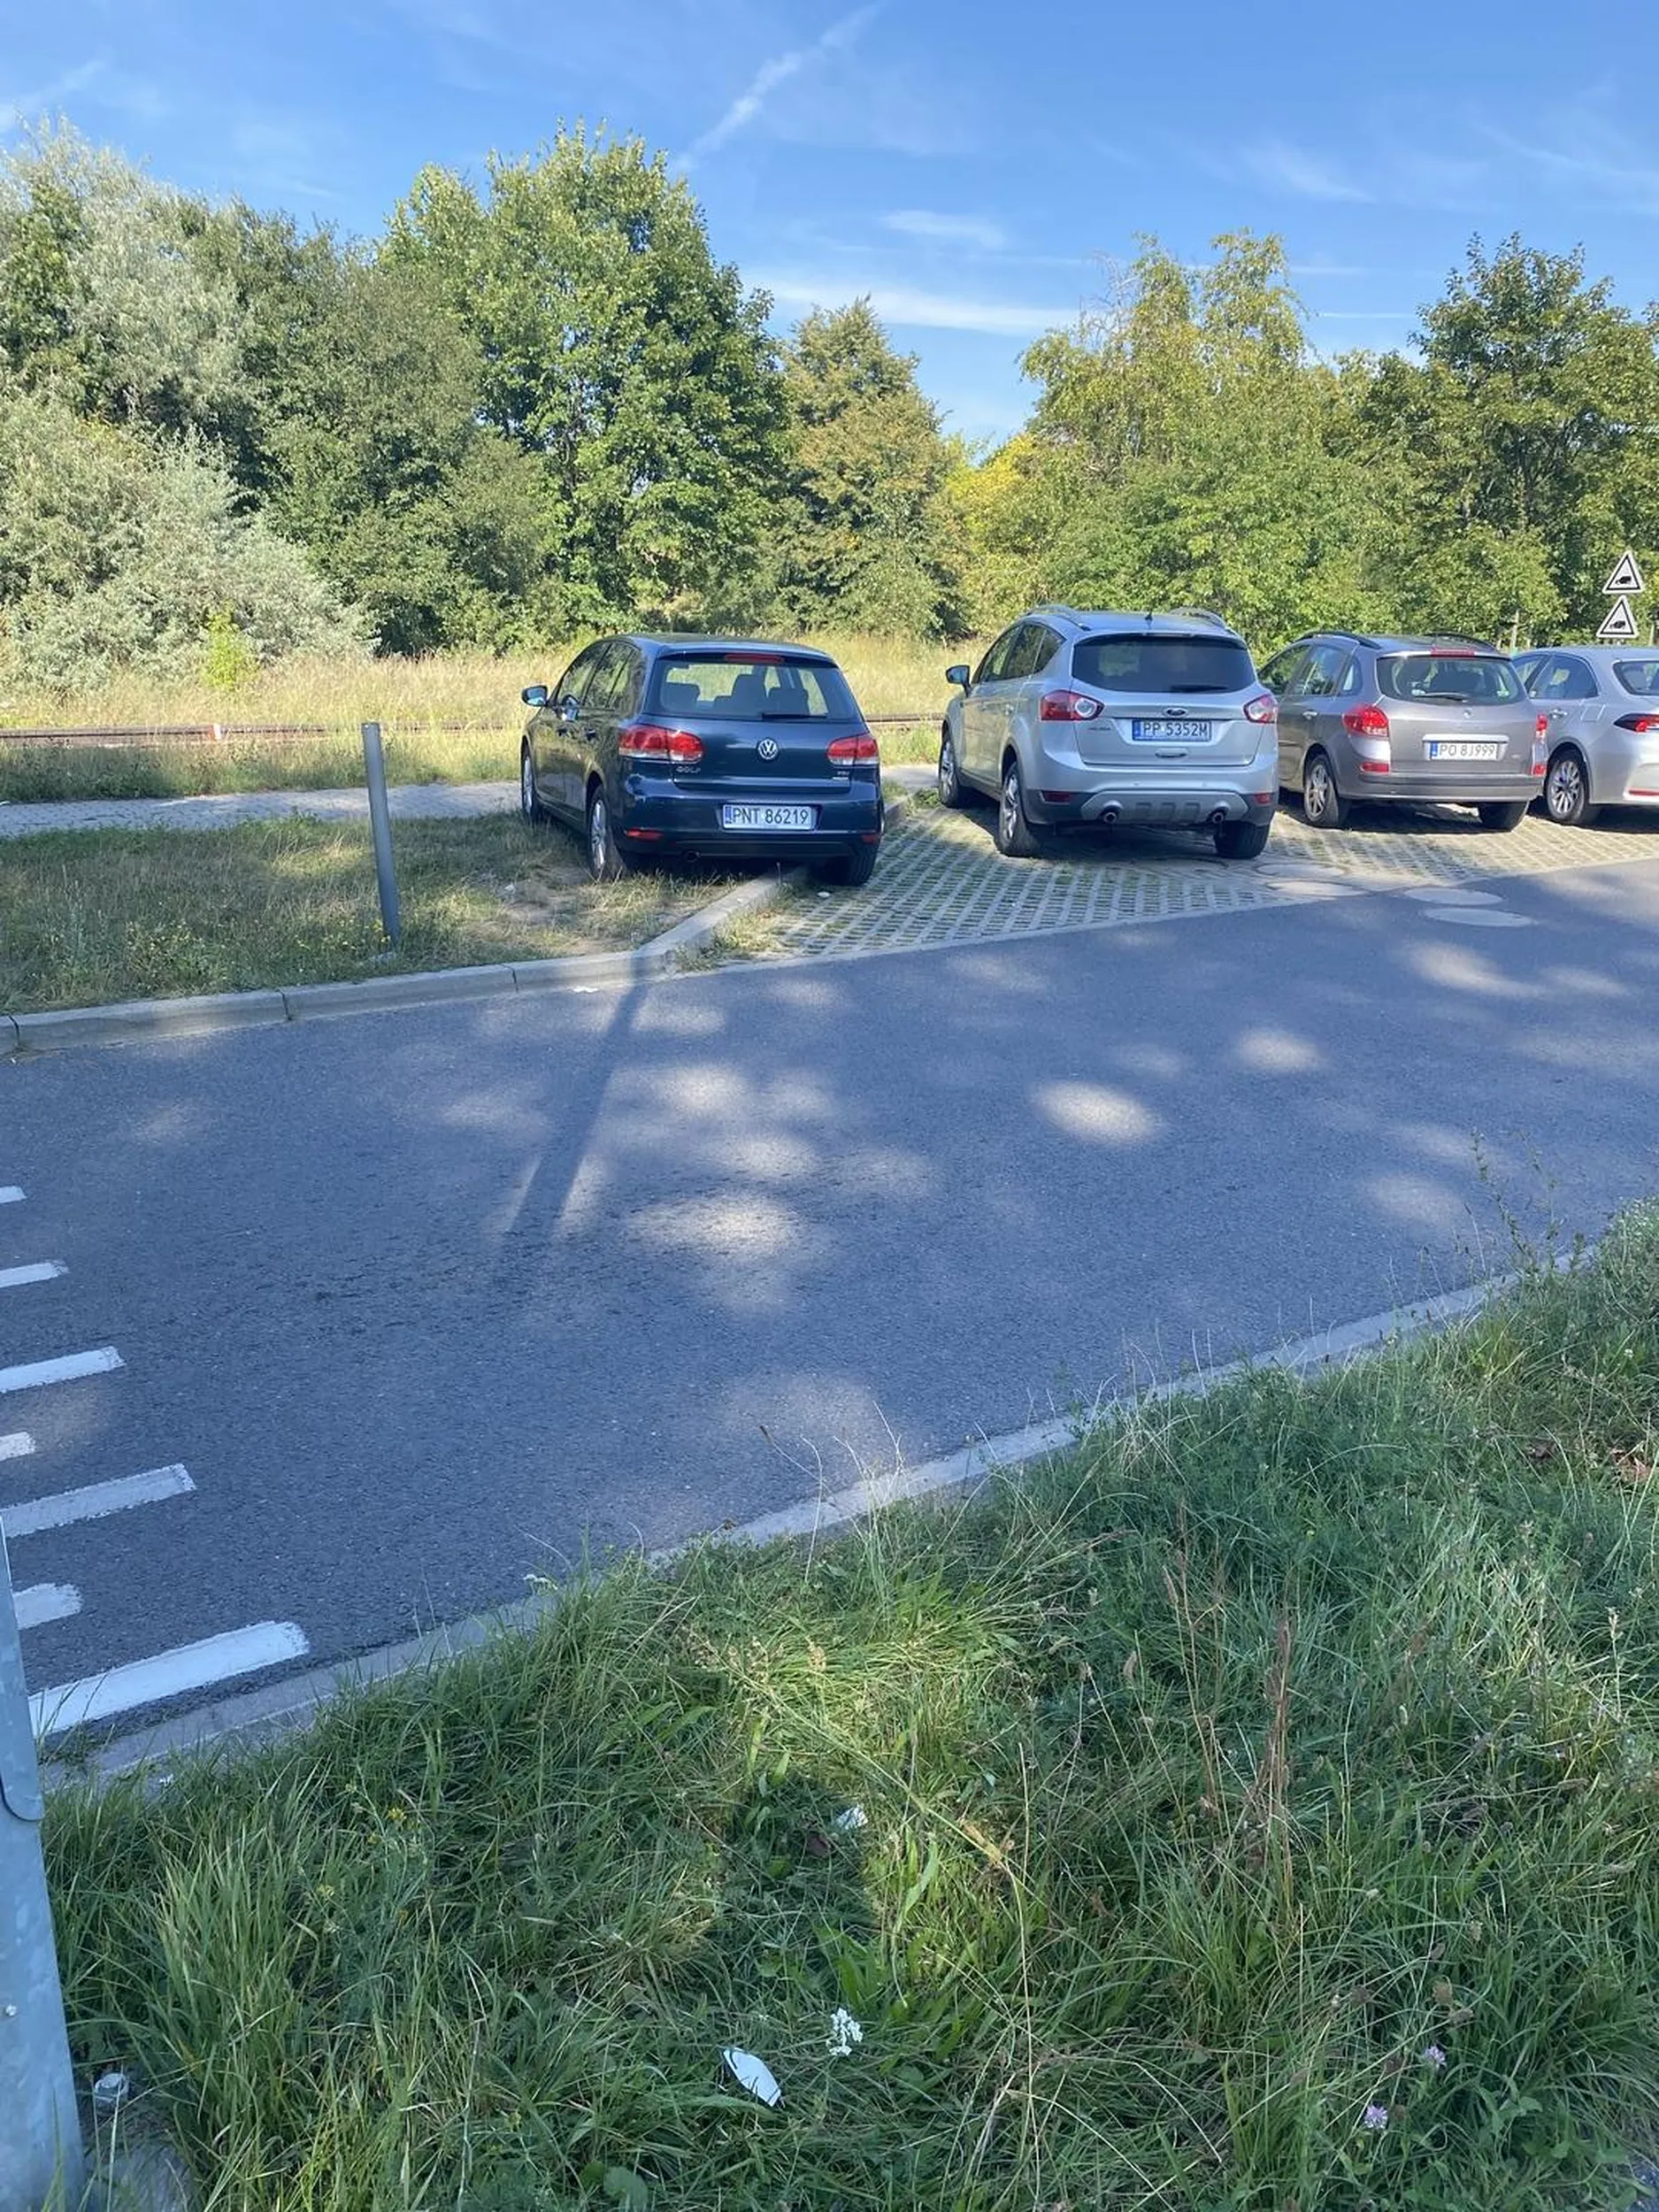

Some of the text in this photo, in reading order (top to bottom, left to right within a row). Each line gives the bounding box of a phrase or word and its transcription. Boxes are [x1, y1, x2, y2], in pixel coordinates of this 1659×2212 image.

[1143, 722, 1207, 736] PP 5352M
[1440, 744, 1456, 757] PO
[1460, 744, 1495, 757] 8J999
[733, 808, 809, 824] PNT 86219
